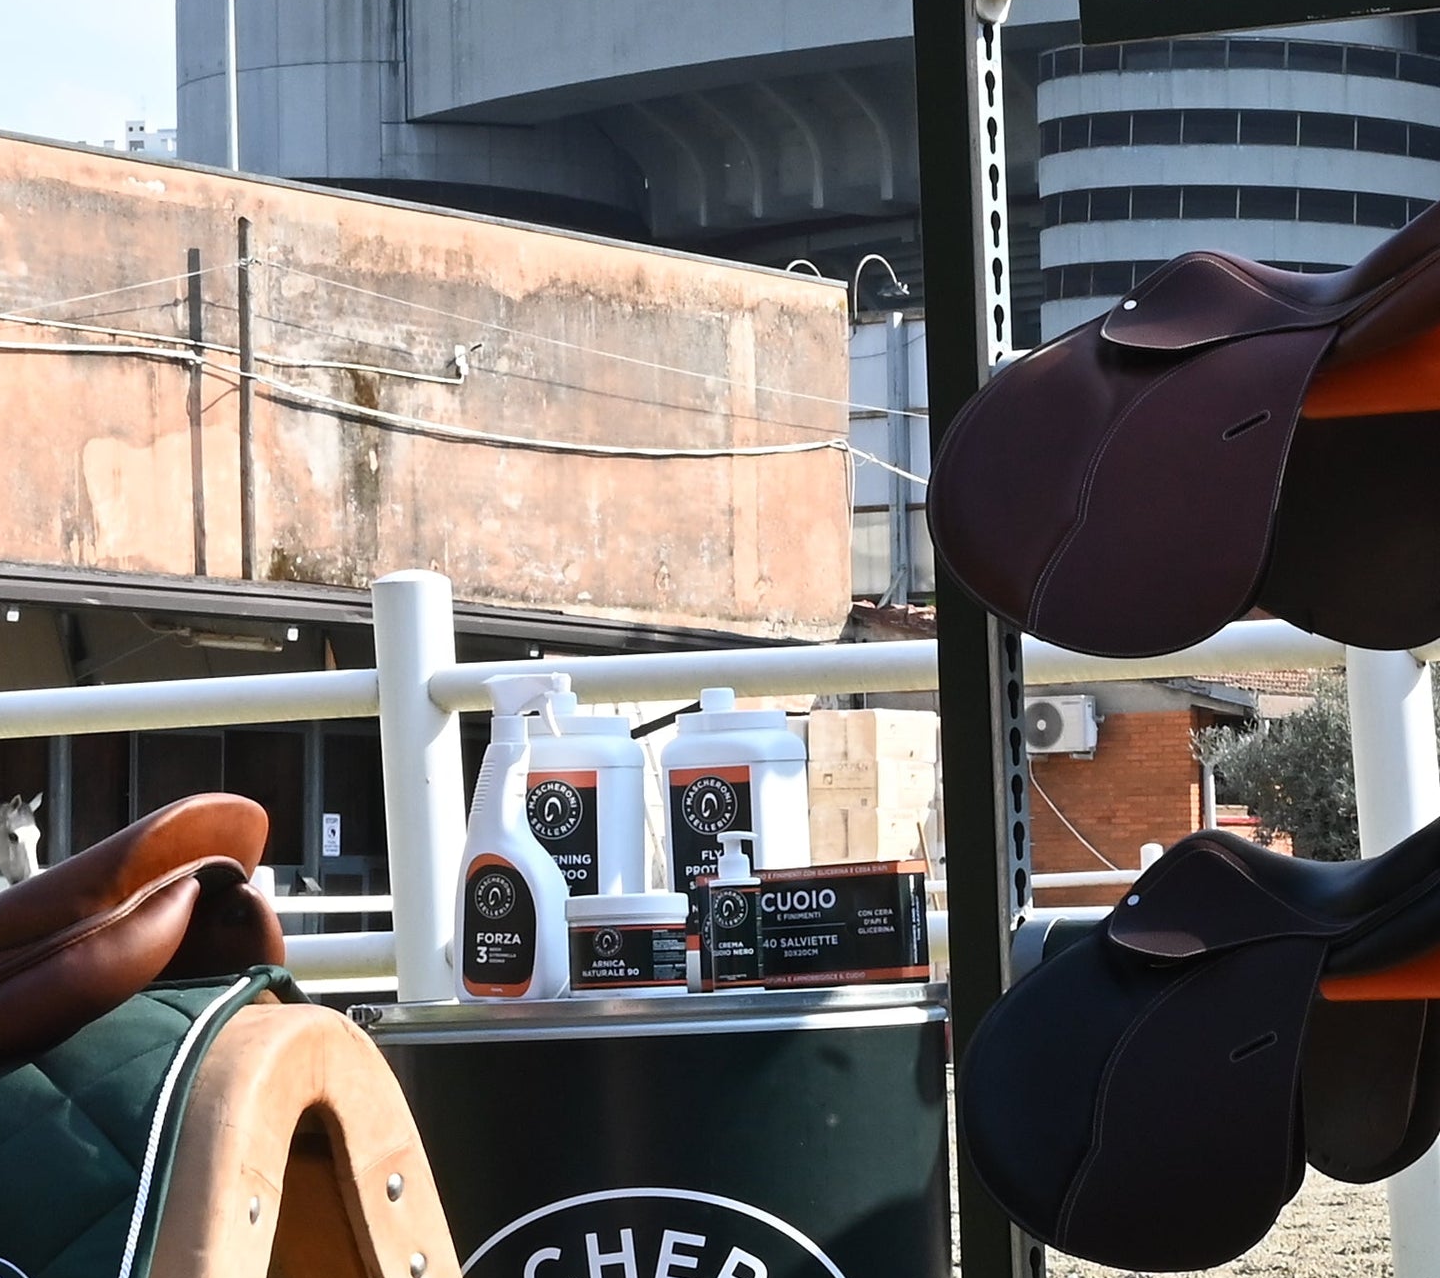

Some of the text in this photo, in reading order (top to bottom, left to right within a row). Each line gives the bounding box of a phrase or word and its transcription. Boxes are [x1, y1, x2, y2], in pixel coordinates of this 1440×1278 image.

[529, 783, 577, 809] MASCHERONI
[686, 779, 732, 805] MASCHERONI
[530, 817, 577, 836] SELLERIA
[761, 889, 836, 913] CUOIO
[783, 911, 821, 920] FINIMENTI
[874, 908, 893, 916] CERA
[858, 926, 895, 935] GLICERINA
[476, 932, 522, 944] FORZA
[762, 935, 838, 949] 40 SALVIETTE
[476, 946, 488, 963] 3
[592, 959, 626, 968] ARNICA
[582, 968, 639, 977] NATURALE 90
